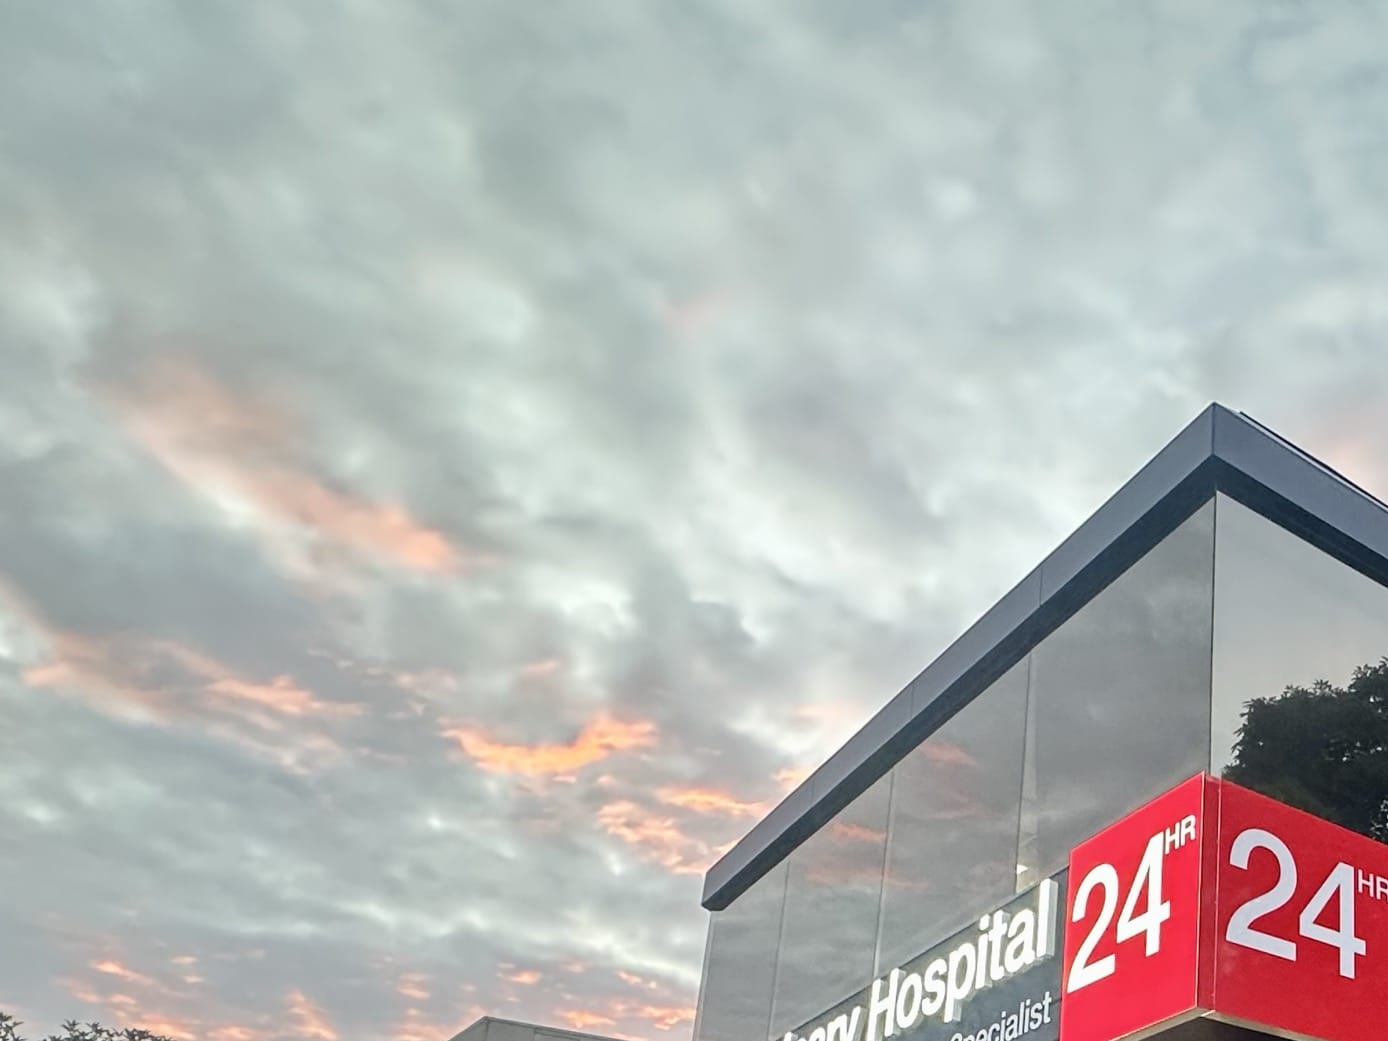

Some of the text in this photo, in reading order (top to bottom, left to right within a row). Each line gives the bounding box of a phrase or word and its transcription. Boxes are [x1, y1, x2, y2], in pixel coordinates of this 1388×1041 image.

[1067, 814, 1196, 993] 24 HR
[1226, 829, 1366, 980] 24
